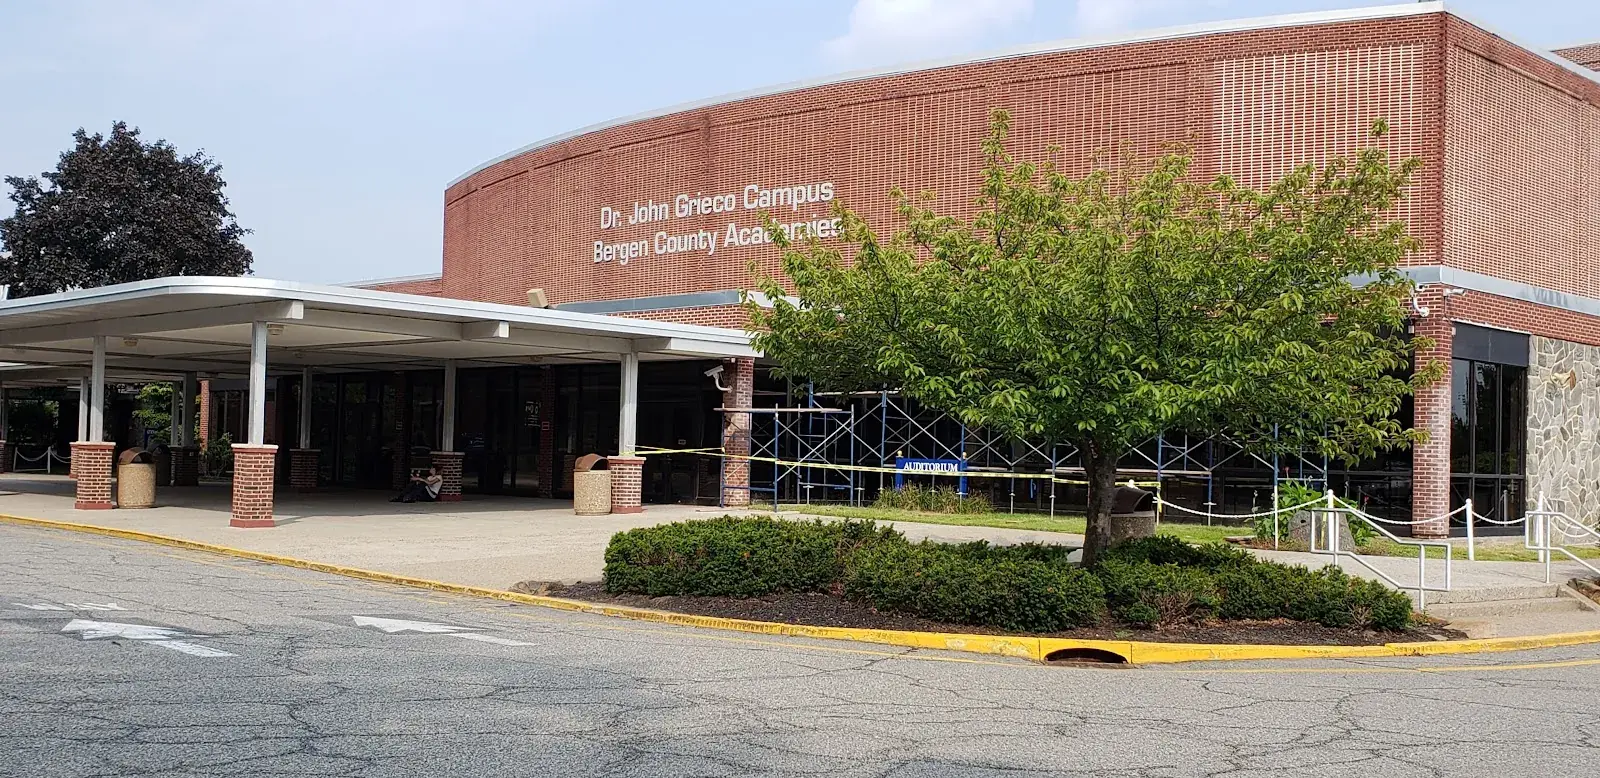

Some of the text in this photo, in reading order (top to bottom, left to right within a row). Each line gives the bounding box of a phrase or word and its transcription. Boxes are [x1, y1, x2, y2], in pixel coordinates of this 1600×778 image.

[600, 182, 834, 230] Dr. John Grieco Campus
[593, 240, 649, 265] Bergen
[654, 229, 718, 256] County
[903, 461, 959, 473] AUDITORIUM
